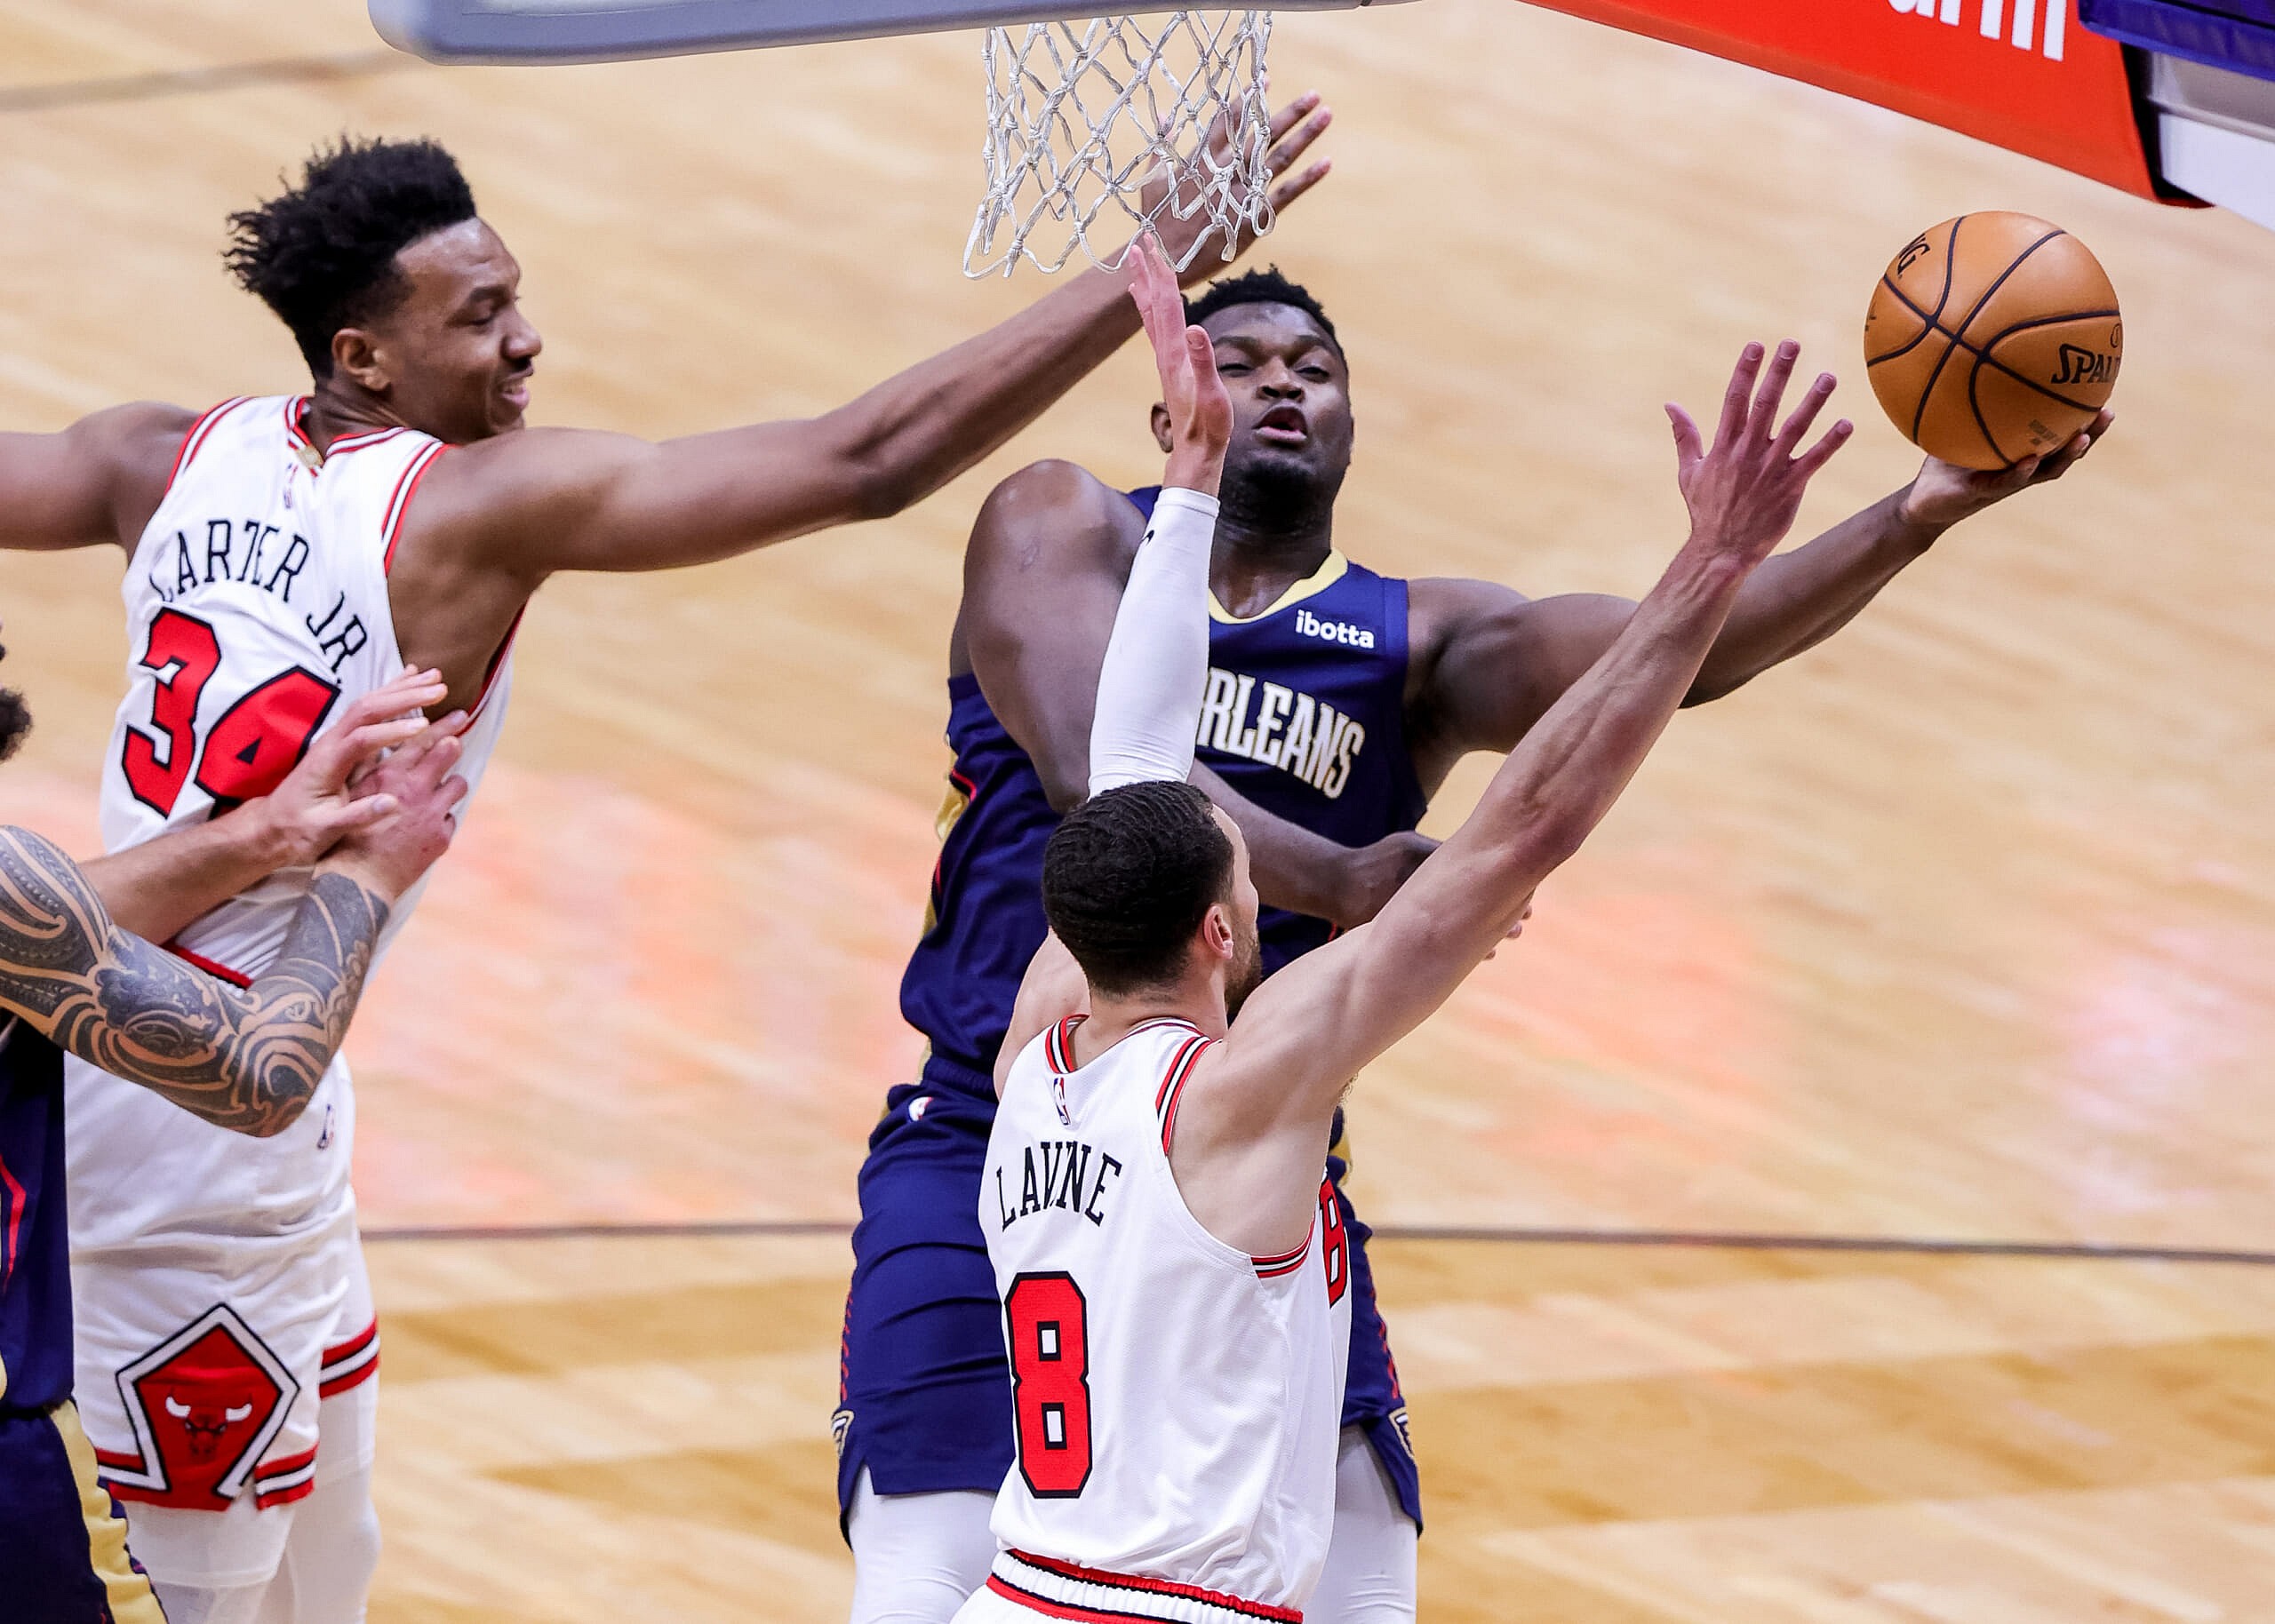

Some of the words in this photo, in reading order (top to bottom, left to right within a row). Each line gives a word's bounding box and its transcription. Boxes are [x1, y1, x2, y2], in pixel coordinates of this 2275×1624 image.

[1295, 609, 1375, 649] ibotta
[122, 607, 341, 820] 34
[1196, 666, 1366, 800] RLEANS
[996, 1140, 1122, 1232] LAVNE
[1004, 1270, 1092, 1499] 8
